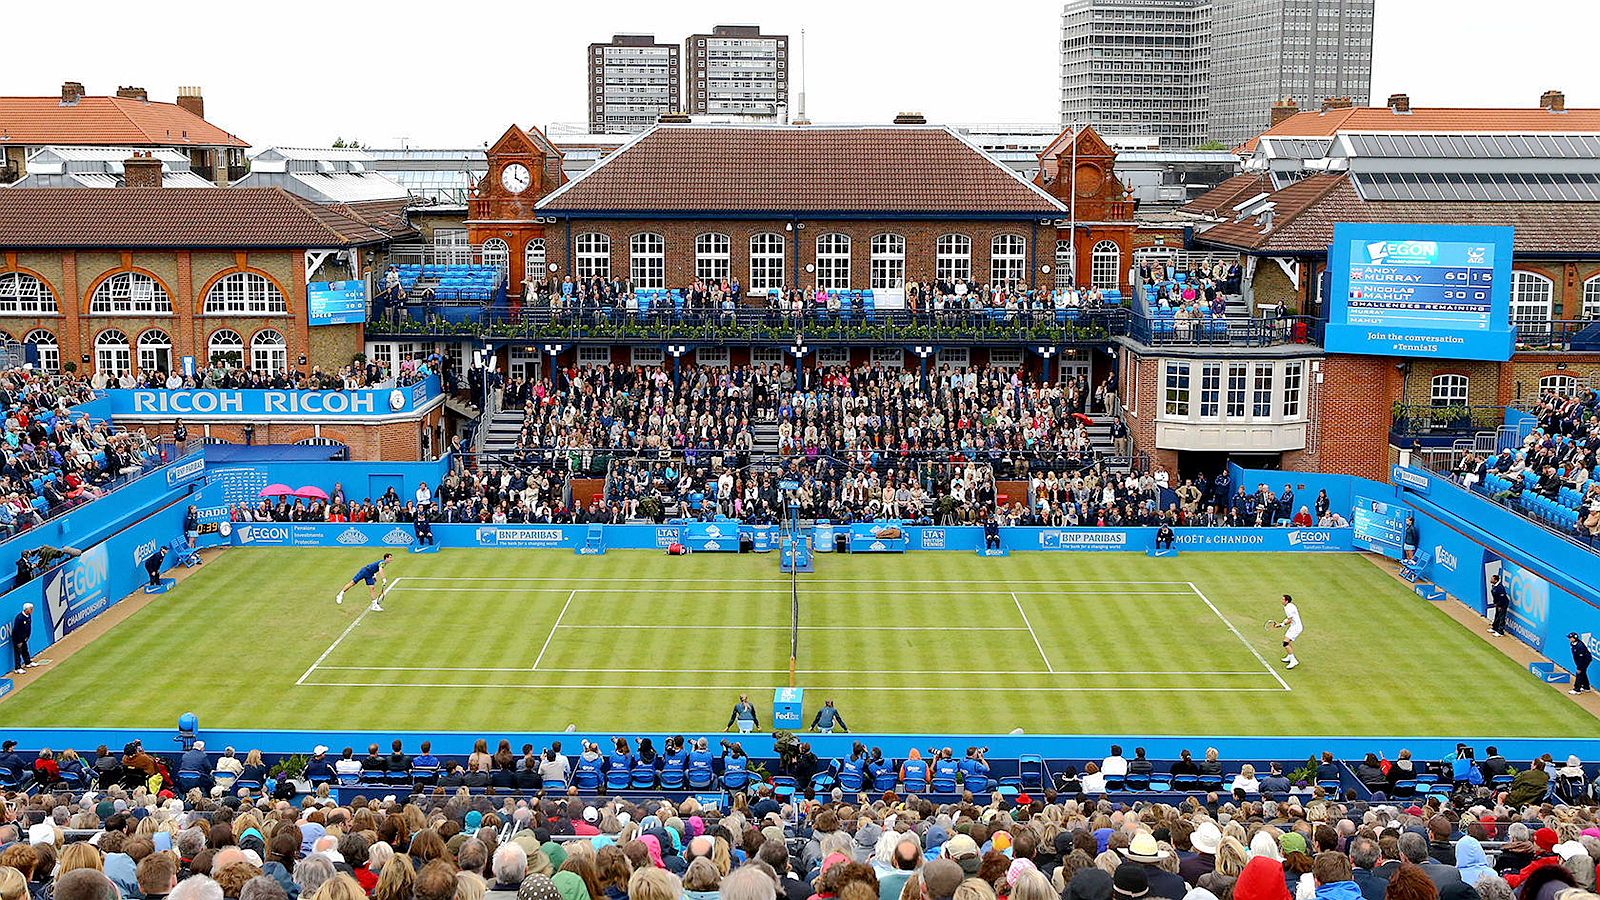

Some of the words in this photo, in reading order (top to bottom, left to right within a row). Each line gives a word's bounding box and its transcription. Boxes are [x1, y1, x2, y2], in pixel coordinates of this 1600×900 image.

[1380, 243, 1435, 257] AEGON
[1364, 274, 1422, 282] MURRAY
[1472, 273, 1493, 281] 15
[1363, 293, 1412, 301] MAHUT
[1352, 301, 1421, 309] CHALLENGES
[1425, 304, 1485, 312] REMAINING
[1368, 332, 1386, 340] Join
[1404, 335, 1464, 343] conversation
[134, 392, 243, 412] RICOH
[264, 392, 373, 412] RICOH
[197, 507, 227, 518] RADO
[197, 522, 218, 534] 0:39
[246, 527, 288, 540] AEGON
[499, 531, 518, 540] BNP
[520, 531, 558, 540] PARIBAS
[1062, 534, 1080, 542] BNP
[1083, 534, 1122, 543] PARIBAS
[1175, 534, 1204, 544] MOËT
[1205, 536, 1212, 544] &
[1213, 535, 1263, 544] CHANDON
[1294, 531, 1330, 542] AEGON
[136, 539, 157, 562] AEGON
[1438, 549, 1457, 569] AEGON
[57, 557, 107, 608] AEGON
[1501, 569, 1547, 622] EGON
[67, 596, 107, 627] CHAMPIONSHIPS
[0, 621, 13, 641] ON
[775, 711, 799, 720] FedEx
